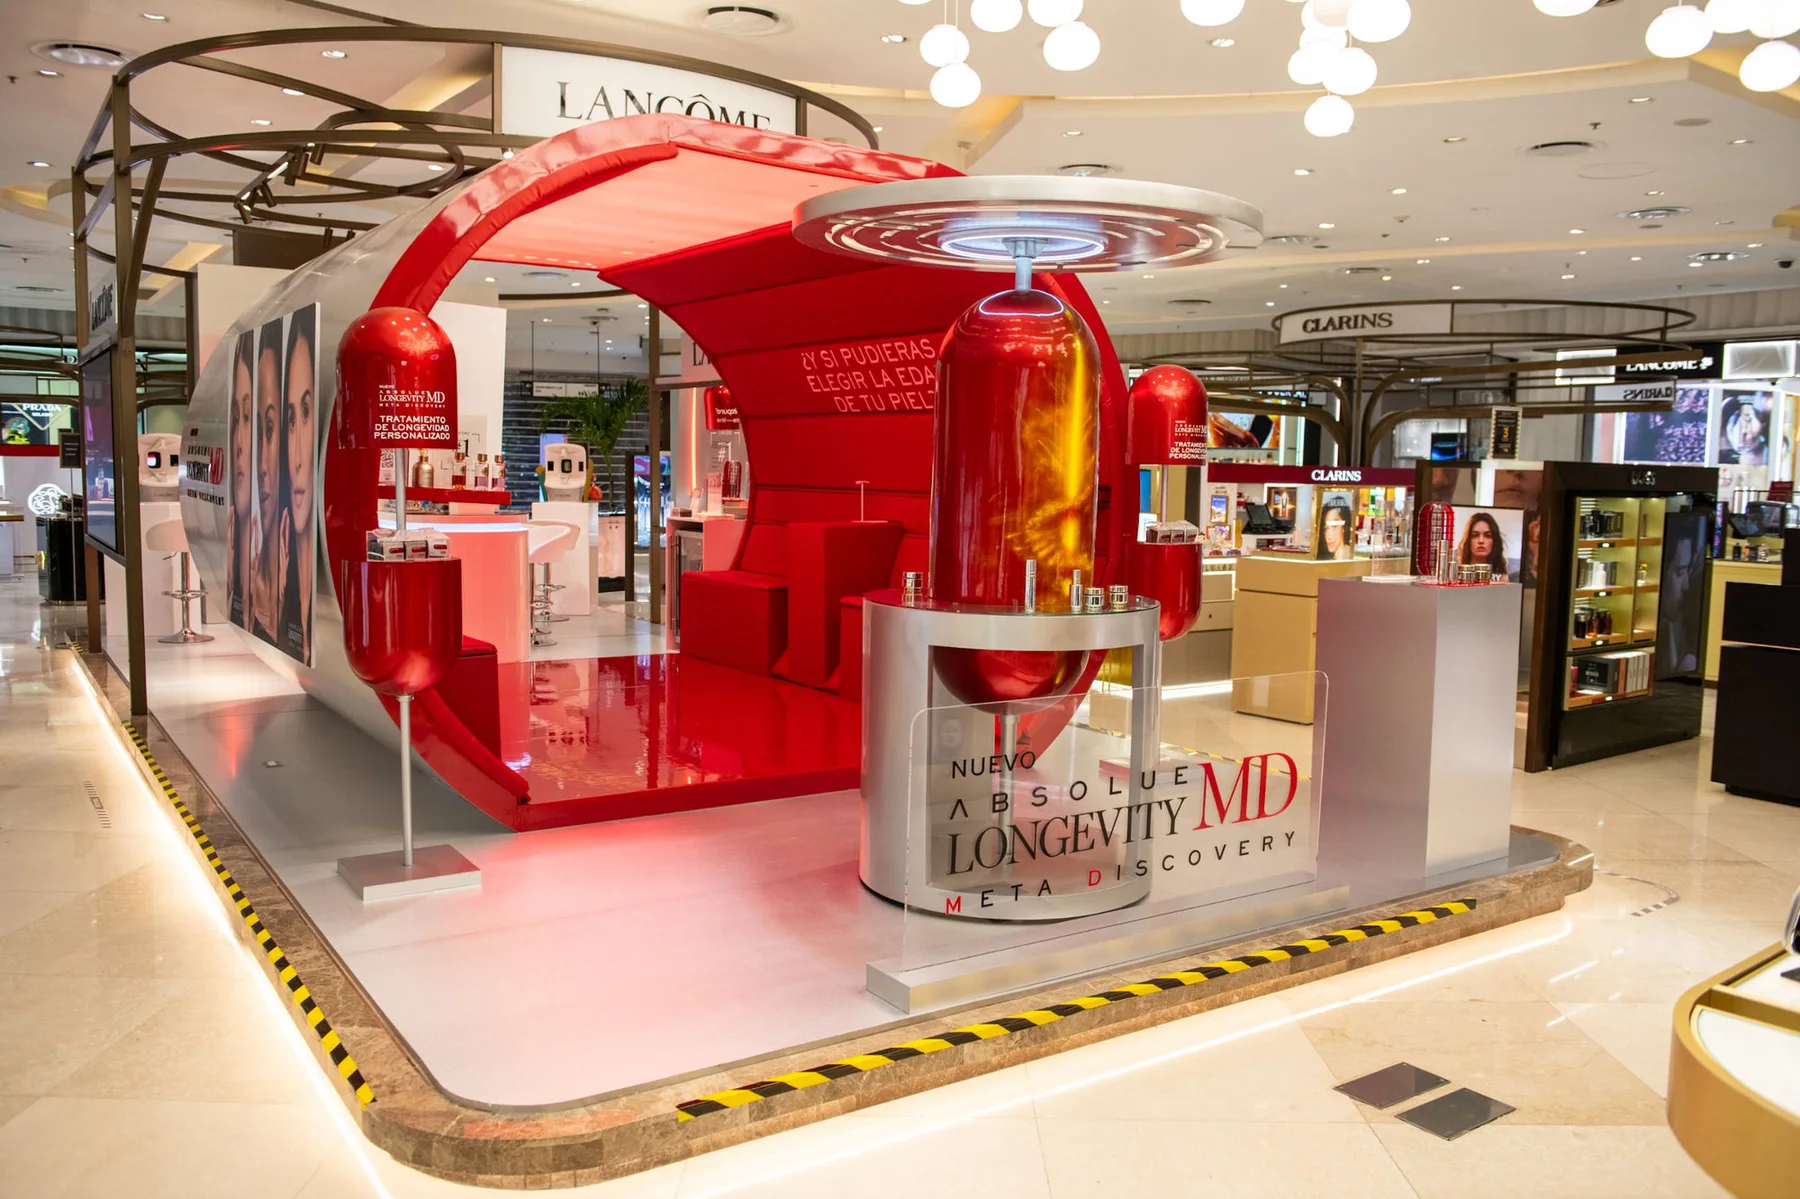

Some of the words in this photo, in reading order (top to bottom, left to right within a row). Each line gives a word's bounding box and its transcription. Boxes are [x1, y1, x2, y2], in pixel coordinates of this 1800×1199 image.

[1302, 312, 1393, 334] CLARINS
[801, 352, 817, 370] ¿Y
[820, 350, 839, 368] SI
[840, 339, 936, 366] PUDIERAS
[807, 371, 868, 392] ELEGIR
[869, 369, 895, 388] LA
[896, 365, 936, 386] EDA
[379, 394, 425, 402] LONGEVITY
[426, 391, 446, 403] MD
[834, 396, 860, 412] DE
[860, 394, 886, 411] TU
[375, 423, 389, 431] DE
[392, 423, 450, 432] LONGEVIDAD
[379, 415, 446, 424] TRATAMIENTO
[374, 431, 451, 440] PERSONALIZADO
[1311, 470, 1362, 481] CLARINS
[952, 751, 1036, 779] NUEVO
[949, 766, 1189, 820] ABSOLUE
[946, 796, 1188, 875] LONGEVITY
[1192, 752, 1298, 831] MD
[945, 879, 1052, 916] META
[1088, 831, 1296, 886] DISCOVERY
